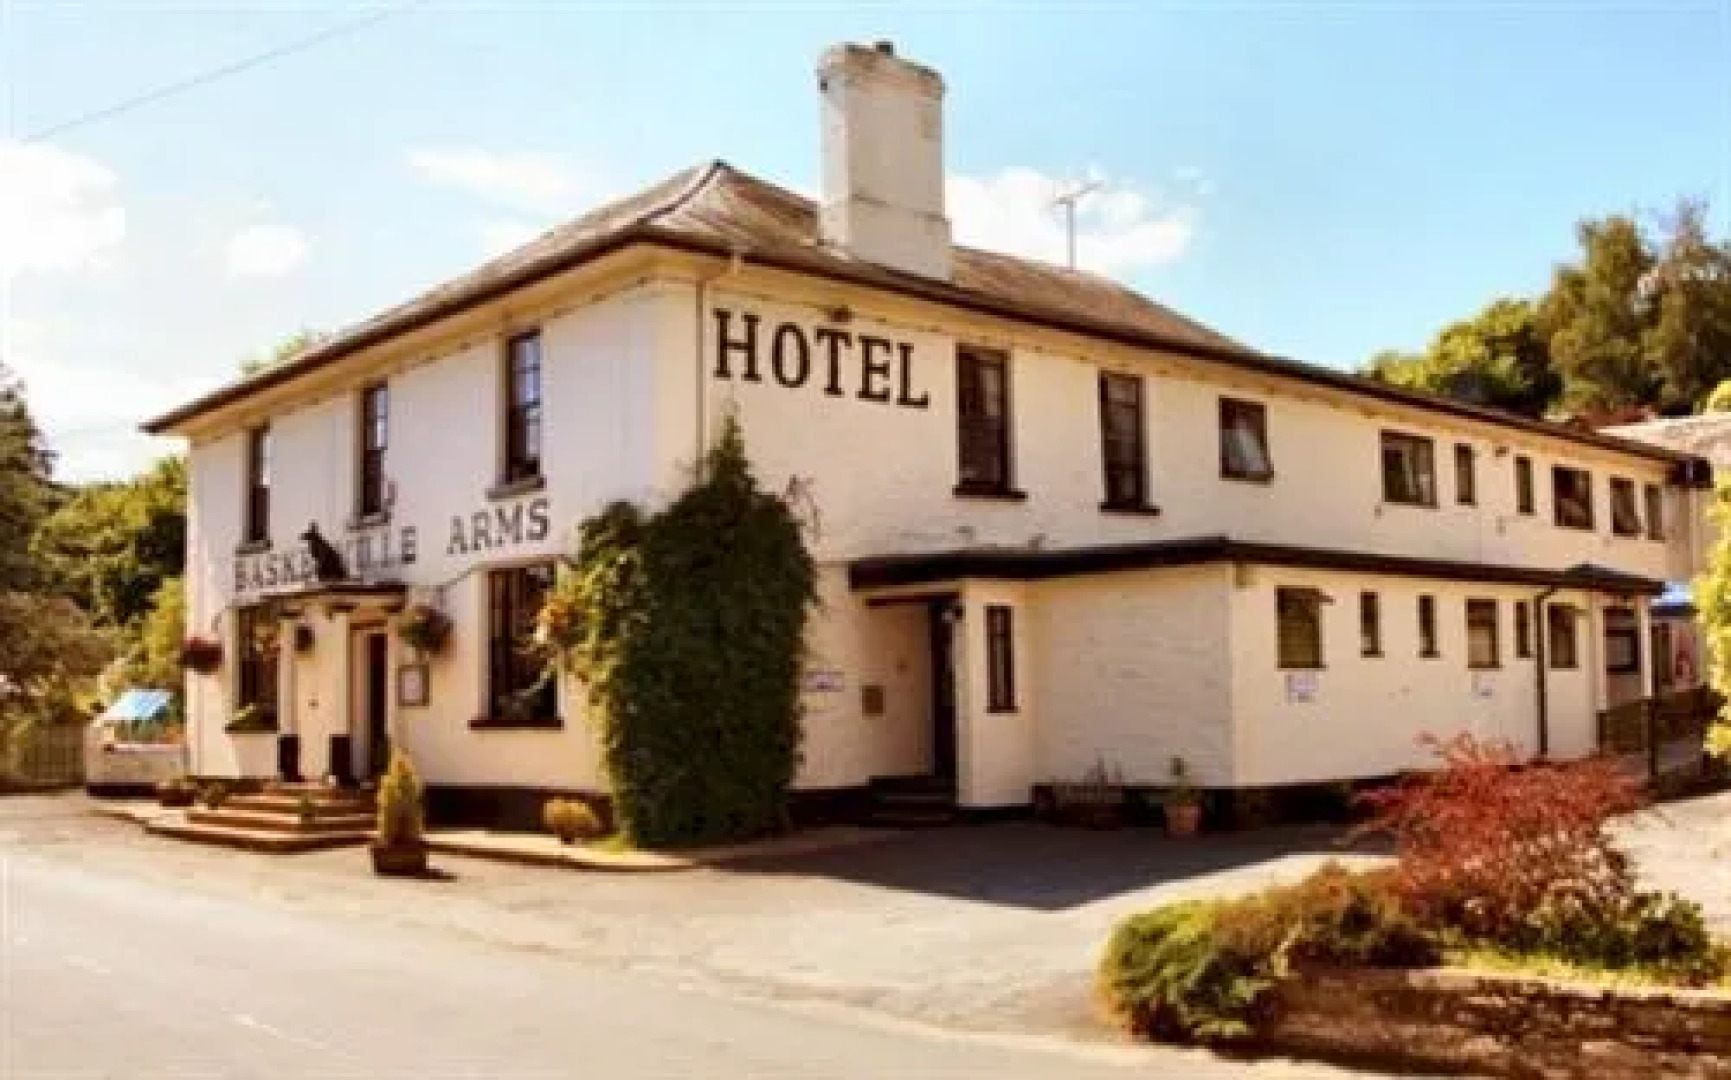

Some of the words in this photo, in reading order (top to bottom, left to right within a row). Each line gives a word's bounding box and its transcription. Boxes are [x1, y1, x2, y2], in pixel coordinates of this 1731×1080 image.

[712, 307, 930, 410] HOTEL
[234, 525, 418, 592] BASKEVILLE
[447, 498, 550, 555] ARMS
